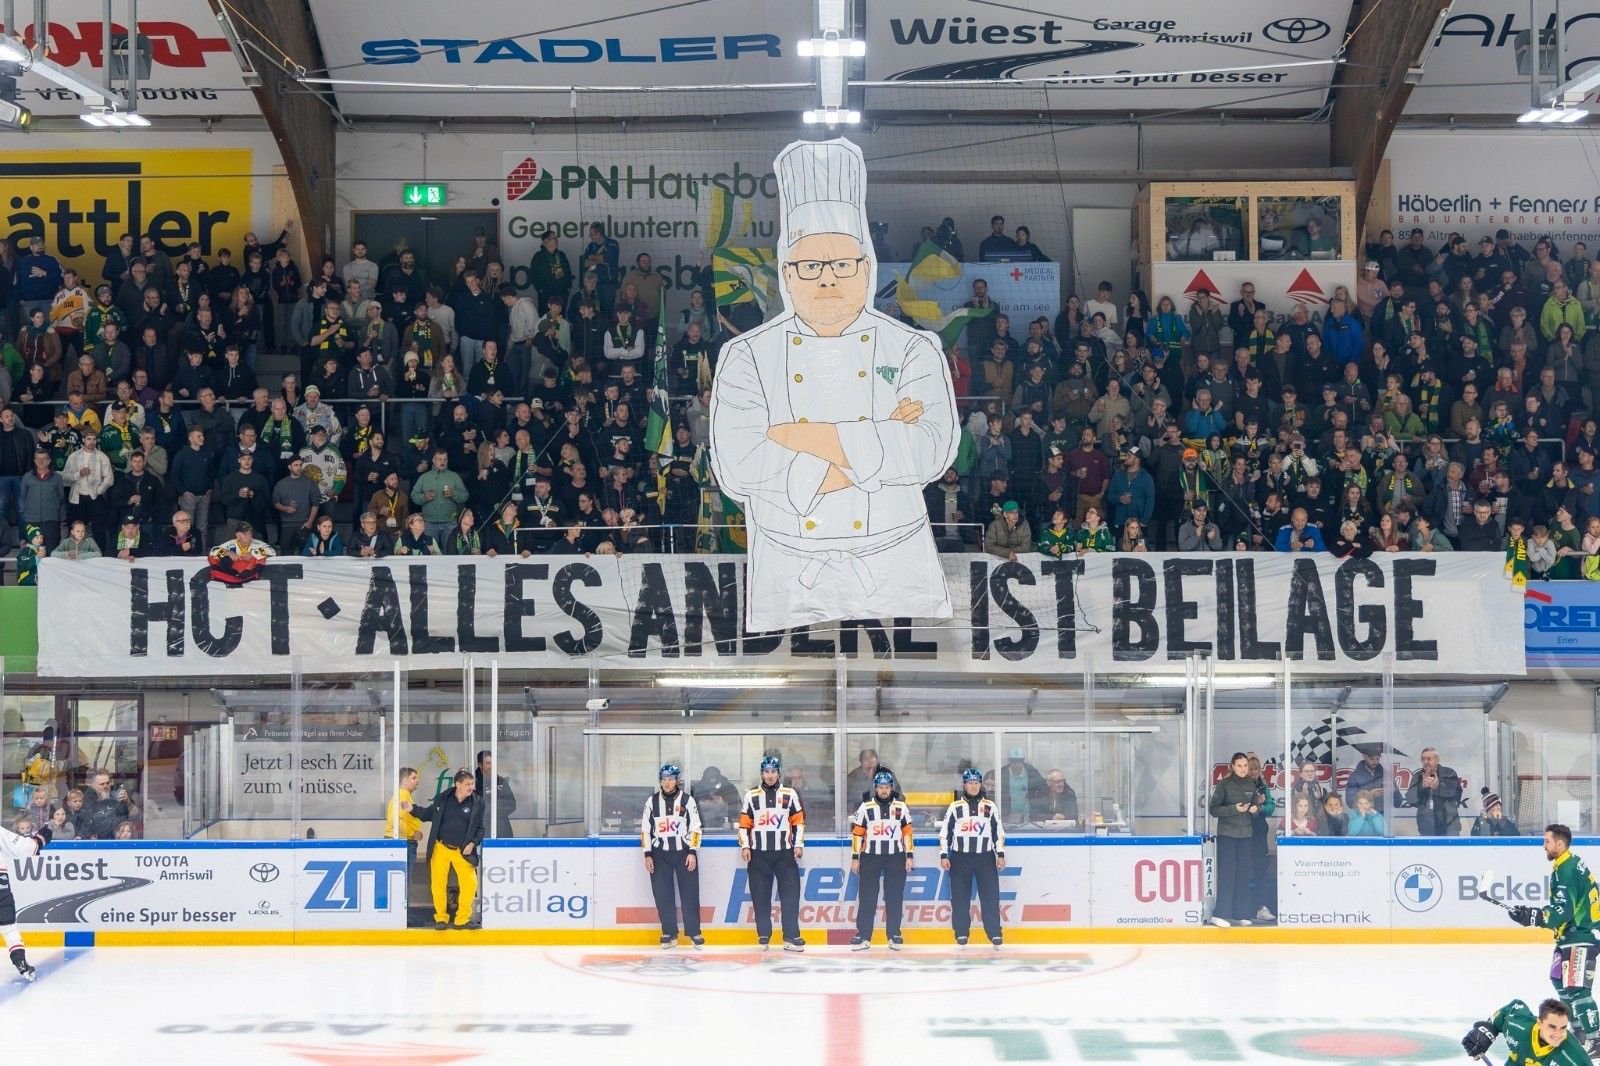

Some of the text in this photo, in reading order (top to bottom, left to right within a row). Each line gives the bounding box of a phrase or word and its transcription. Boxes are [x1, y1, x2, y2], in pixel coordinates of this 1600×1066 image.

[890, 17, 1177, 45] Wüest Garage
[1155, 31, 1253, 44] Amriswil
[361, 33, 783, 65] STADLER
[1113, 69, 1183, 87] Spur
[1190, 69, 1289, 84] besser
[1399, 194, 1482, 213] Häberlin
[1489, 199, 1502, 211] +
[1508, 195, 1588, 213] Fenners
[1024, 267, 1055, 275] MEDICAL
[1024, 274, 1055, 282] PARTNER
[130, 563, 304, 658] HCT
[354, 563, 603, 656] ALLES
[969, 558, 1086, 661] IST
[1112, 557, 1438, 662] BEILAGE
[1557, 635, 1578, 645] Erlen
[240, 753, 283, 775] Jetzt
[342, 753, 375, 770] Ziit
[243, 781, 282, 794] zum
[658, 817, 681, 835] sky
[758, 810, 784, 830] sky
[960, 818, 986, 836] sky
[872, 821, 898, 839] sky
[14, 855, 189, 882] Wüest TOYOTA
[159, 868, 213, 881] Amriswil
[482, 859, 558, 884] eifel
[1205, 857, 1214, 897] RAITA
[1458, 875, 1550, 901] Bckel
[100, 907, 237, 926] eine Spur besser
